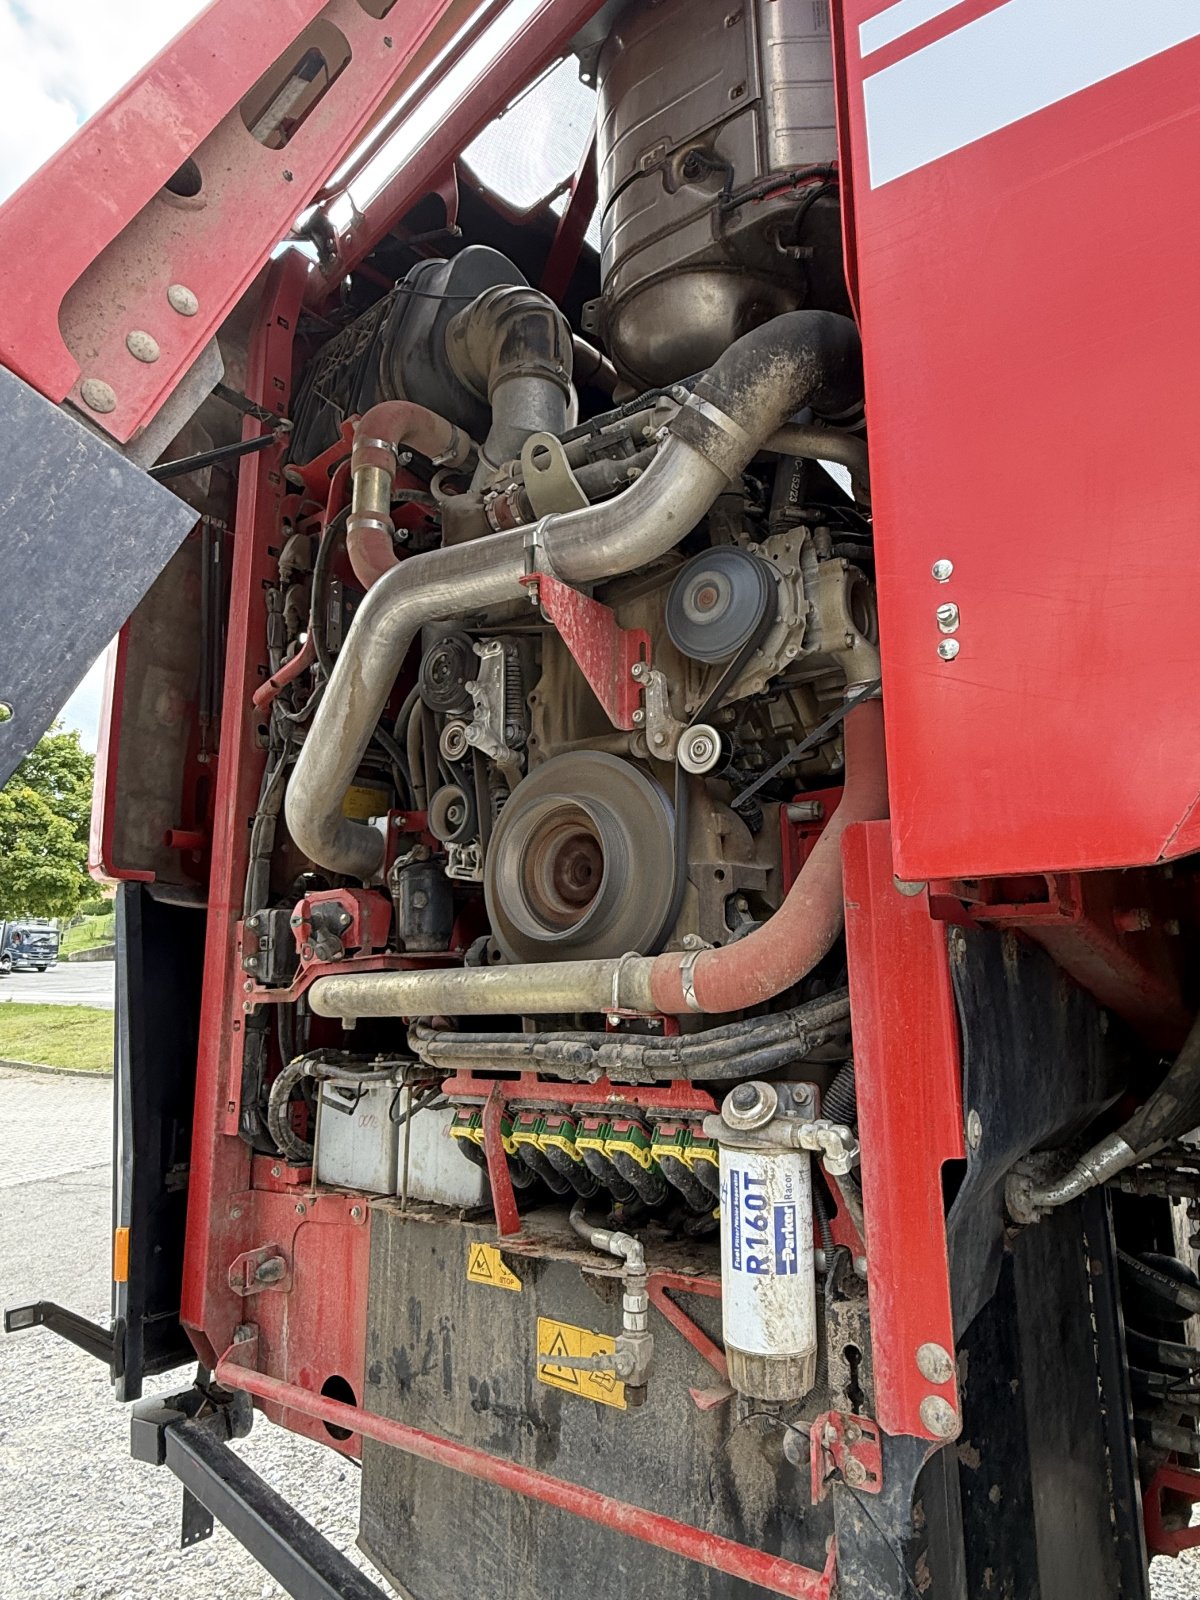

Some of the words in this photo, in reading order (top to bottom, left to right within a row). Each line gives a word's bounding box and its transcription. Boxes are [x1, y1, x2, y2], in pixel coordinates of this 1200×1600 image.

[784, 1173, 793, 1200] Racor
[744, 1172, 770, 1275] R160T
[781, 1206, 795, 1262] Parker
[500, 1276, 514, 1285] STOP
